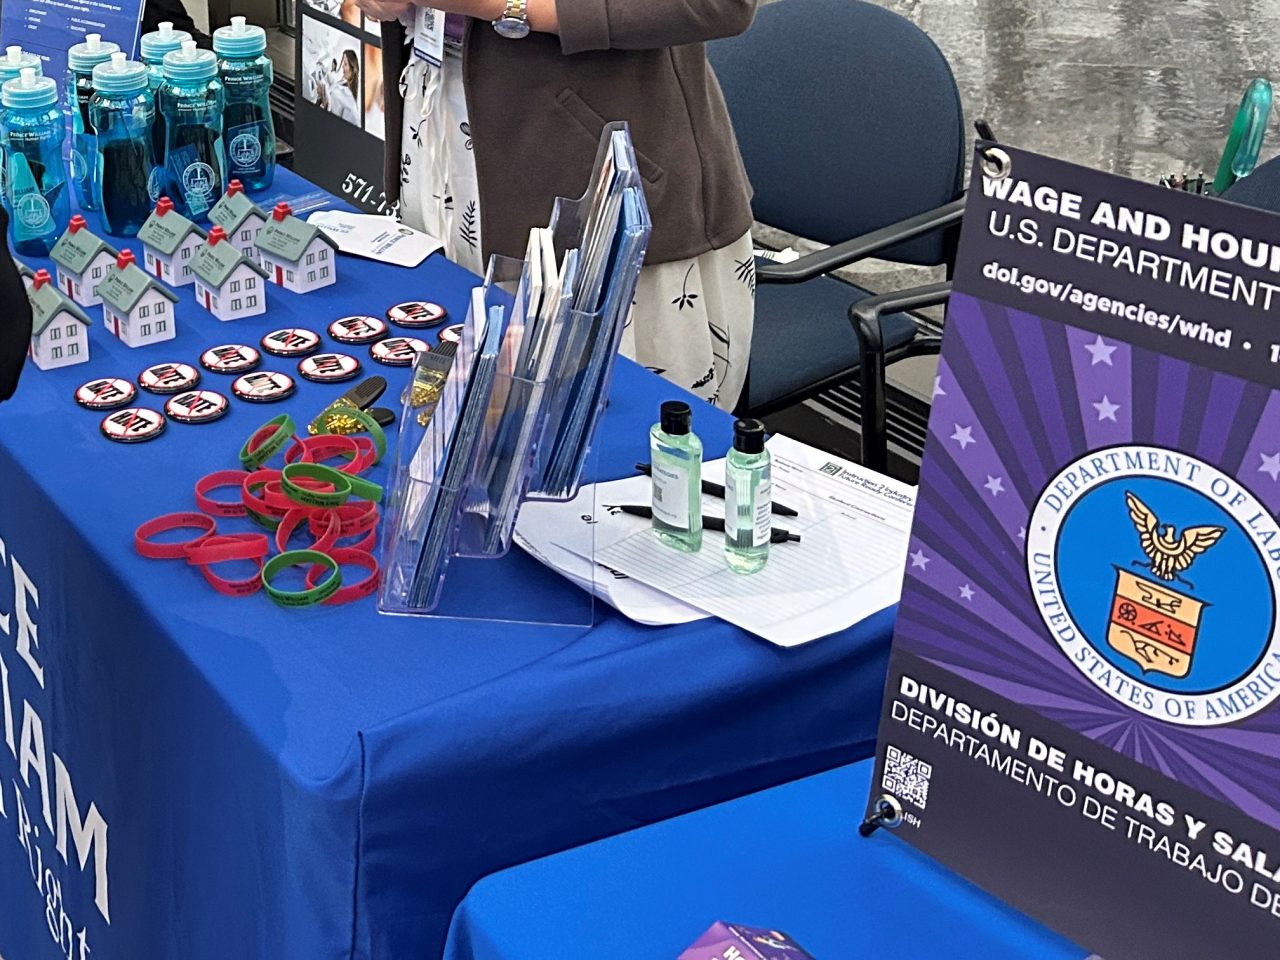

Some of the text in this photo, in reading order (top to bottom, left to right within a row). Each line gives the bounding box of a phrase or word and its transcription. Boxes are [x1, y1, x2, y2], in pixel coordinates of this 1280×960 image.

[982, 176, 1082, 220] WAGE
[1090, 202, 1170, 241] AND
[988, 209, 1280, 311] U.S. DEPARTMENT
[982, 261, 1233, 349] dol.gov/agencies/whd
[1043, 450, 1280, 580] DEPARTMENT OF LAB
[1033, 552, 1076, 643] UNITED
[1075, 646, 1154, 711] STATES
[1165, 697, 1196, 720] OF
[891, 700, 1077, 807] DEPARTAMENTO
[1083, 796, 1117, 831] DE
[1124, 816, 1244, 894] TRABAJO
[899, 675, 1021, 750] DIVISIÓN
[1028, 737, 1065, 772] DE
[1072, 758, 1175, 827] HORAS
[1183, 814, 1207, 840] Y
